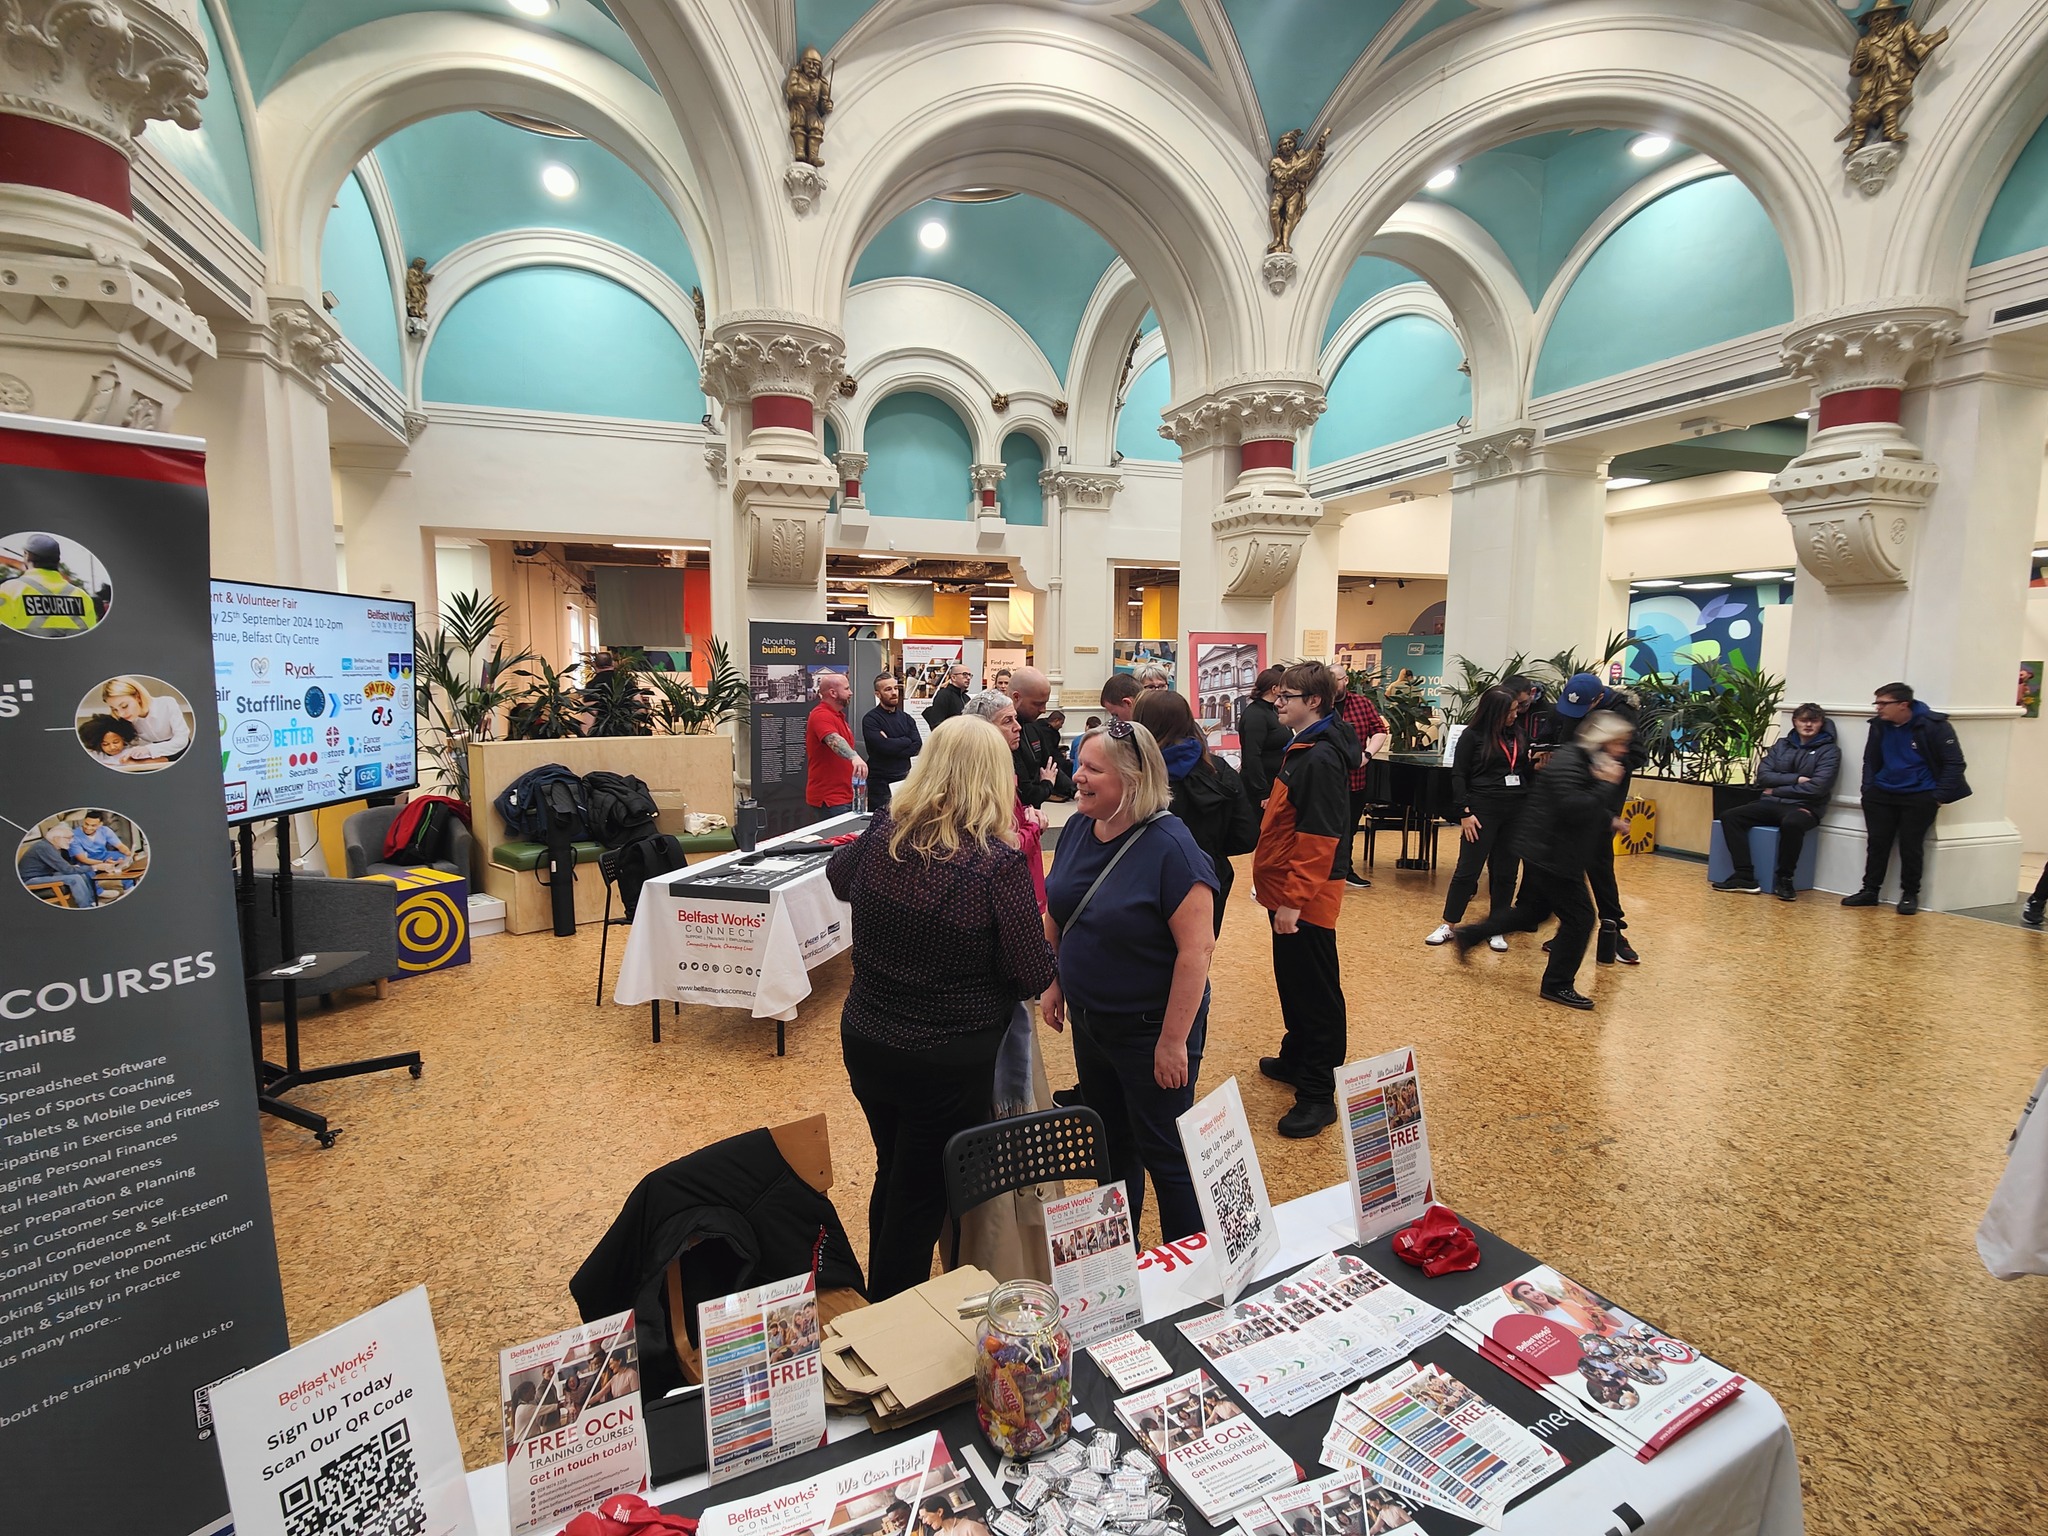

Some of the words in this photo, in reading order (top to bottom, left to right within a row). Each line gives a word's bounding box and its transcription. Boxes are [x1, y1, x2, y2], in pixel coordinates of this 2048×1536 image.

[26, 596, 83, 615] SECURITY
[226, 592, 234, 603] &
[236, 593, 280, 608] Volunteer
[282, 598, 298, 609] Fair
[367, 609, 389, 620] Belfast
[390, 611, 410, 622] Works
[221, 611, 240, 623] 25th
[242, 612, 291, 627] September
[293, 616, 312, 628] 2024
[315, 618, 343, 631] 10-2pm
[371, 621, 407, 630] CONNECT
[242, 631, 273, 643] Belfast
[275, 633, 291, 646] City
[293, 634, 319, 646] Centre
[761, 646, 797, 656] building
[762, 637, 783, 645] About
[285, 662, 315, 679] Ryak
[236, 695, 301, 714] Staffline
[343, 693, 362, 706] SFG
[363, 682, 396, 699] SMYTHS
[236, 734, 269, 744] HASTINGS
[273, 727, 313, 748] BETTER
[363, 736, 381, 744] Cancer
[363, 745, 381, 754] Focus
[274, 783, 304, 794] MERCURY
[289, 768, 318, 778] Securitas
[307, 779, 336, 794] Bryson
[360, 770, 377, 781] G2C
[678, 909, 719, 924] Belfast
[721, 913, 761, 928] Works
[685, 925, 754, 938] CONNECT
[0, 951, 216, 1020] COURSES
[0, 1072, 99, 1104] Spreadsheet
[102, 1055, 167, 1079] Software
[35, 1102, 52, 1117] of
[56, 1091, 105, 1111] Sports
[109, 1072, 175, 1097] Coaching
[4, 1124, 62, 1146] Tablets
[66, 1118, 79, 1130] &
[83, 1105, 136, 1125] Mobile
[140, 1087, 192, 1110] Devices
[64, 1141, 78, 1151] in
[83, 1123, 142, 1146] Exercise
[146, 1112, 172, 1128] and
[176, 1098, 220, 1119] Fitness
[1199, 1117, 1214, 1136] Belfast
[1213, 1110, 1227, 1126] Works
[1200, 1146, 1214, 1161] Sign
[1212, 1138, 1221, 1151] Up
[1219, 1127, 1236, 1144] Today
[1390, 1125, 1420, 1149] FREE
[46, 1150, 112, 1178] Personal
[116, 1132, 178, 1157] Finances
[1202, 1164, 1216, 1179] Scan
[1214, 1156, 1224, 1169] Our
[1223, 1149, 1232, 1161] QR
[1231, 1138, 1243, 1154] Code
[25, 1191, 116, 1228] Preparation
[120, 1186, 132, 1198] &
[136, 1165, 196, 1192] Planning
[27, 1181, 79, 1206] Health
[83, 1157, 163, 1188] Awareness
[1047, 1203, 1070, 1215] Belfast
[1071, 1195, 1093, 1207] Works
[1051, 1206, 1091, 1220] CONNECT
[14, 1242, 28, 1254] in
[33, 1215, 108, 1246] Customer
[112, 1197, 164, 1220] Service
[46, 1228, 131, 1262] Confidence
[136, 1221, 148, 1232] &
[151, 1194, 228, 1227] Self-Esteem
[47, 1285, 85, 1306] Skills
[90, 1275, 111, 1290] for
[115, 1265, 139, 1280] the
[143, 1241, 207, 1270] Domestic
[210, 1218, 254, 1246] Kitchen
[73, 1233, 172, 1275] Development
[39, 1318, 52, 1330] &
[56, 1299, 103, 1323] Safety
[107, 1292, 121, 1304] in
[125, 1269, 181, 1297] Practice
[22, 1335, 65, 1359] many
[69, 1316, 121, 1339] more...
[510, 1347, 535, 1359] Belfast
[536, 1339, 560, 1351] Works
[1658, 1343, 1683, 1358] 30
[42, 1390, 69, 1407] the
[73, 1363, 131, 1394] training
[175, 1333, 199, 1350] like
[202, 1327, 218, 1340] us
[220, 1319, 234, 1332] to
[1104, 1353, 1129, 1365] Belfast
[1129, 1345, 1151, 1357] Works
[278, 1372, 328, 1406] Belfast
[330, 1349, 375, 1379] Works
[290, 1364, 369, 1412] CONNECT
[770, 1356, 818, 1388] FREE
[267, 1420, 308, 1451] Sign
[312, 1405, 338, 1424] Up
[341, 1373, 393, 1409] Today
[1449, 1403, 1487, 1430] FREE
[262, 1450, 306, 1481] Scan
[310, 1427, 342, 1453] Our
[346, 1411, 370, 1433] QR
[374, 1386, 414, 1416] Code
[528, 1426, 579, 1458] FREE
[585, 1405, 634, 1437] OCN
[530, 1444, 583, 1470] TRAINING
[586, 1424, 634, 1449] COURSES
[1174, 1438, 1214, 1463] FREE
[1214, 1422, 1253, 1445] OCN
[529, 1472, 554, 1486] Get
[554, 1467, 565, 1477] in
[567, 1452, 600, 1472] touch
[603, 1436, 638, 1460] today!
[1184, 1448, 1224, 1470] TRAINING
[1223, 1434, 1260, 1452] COURSES
[1191, 1466, 1208, 1479] Get
[1209, 1462, 1218, 1472] in
[1218, 1452, 1243, 1468] touch
[1243, 1440, 1270, 1460] today!
[836, 1478, 858, 1495] We
[862, 1468, 889, 1485] Can
[892, 1451, 925, 1475] Help!
[727, 1503, 772, 1526] Belfast
[773, 1489, 815, 1509] Works
[737, 1502, 811, 1534] CONNECT
